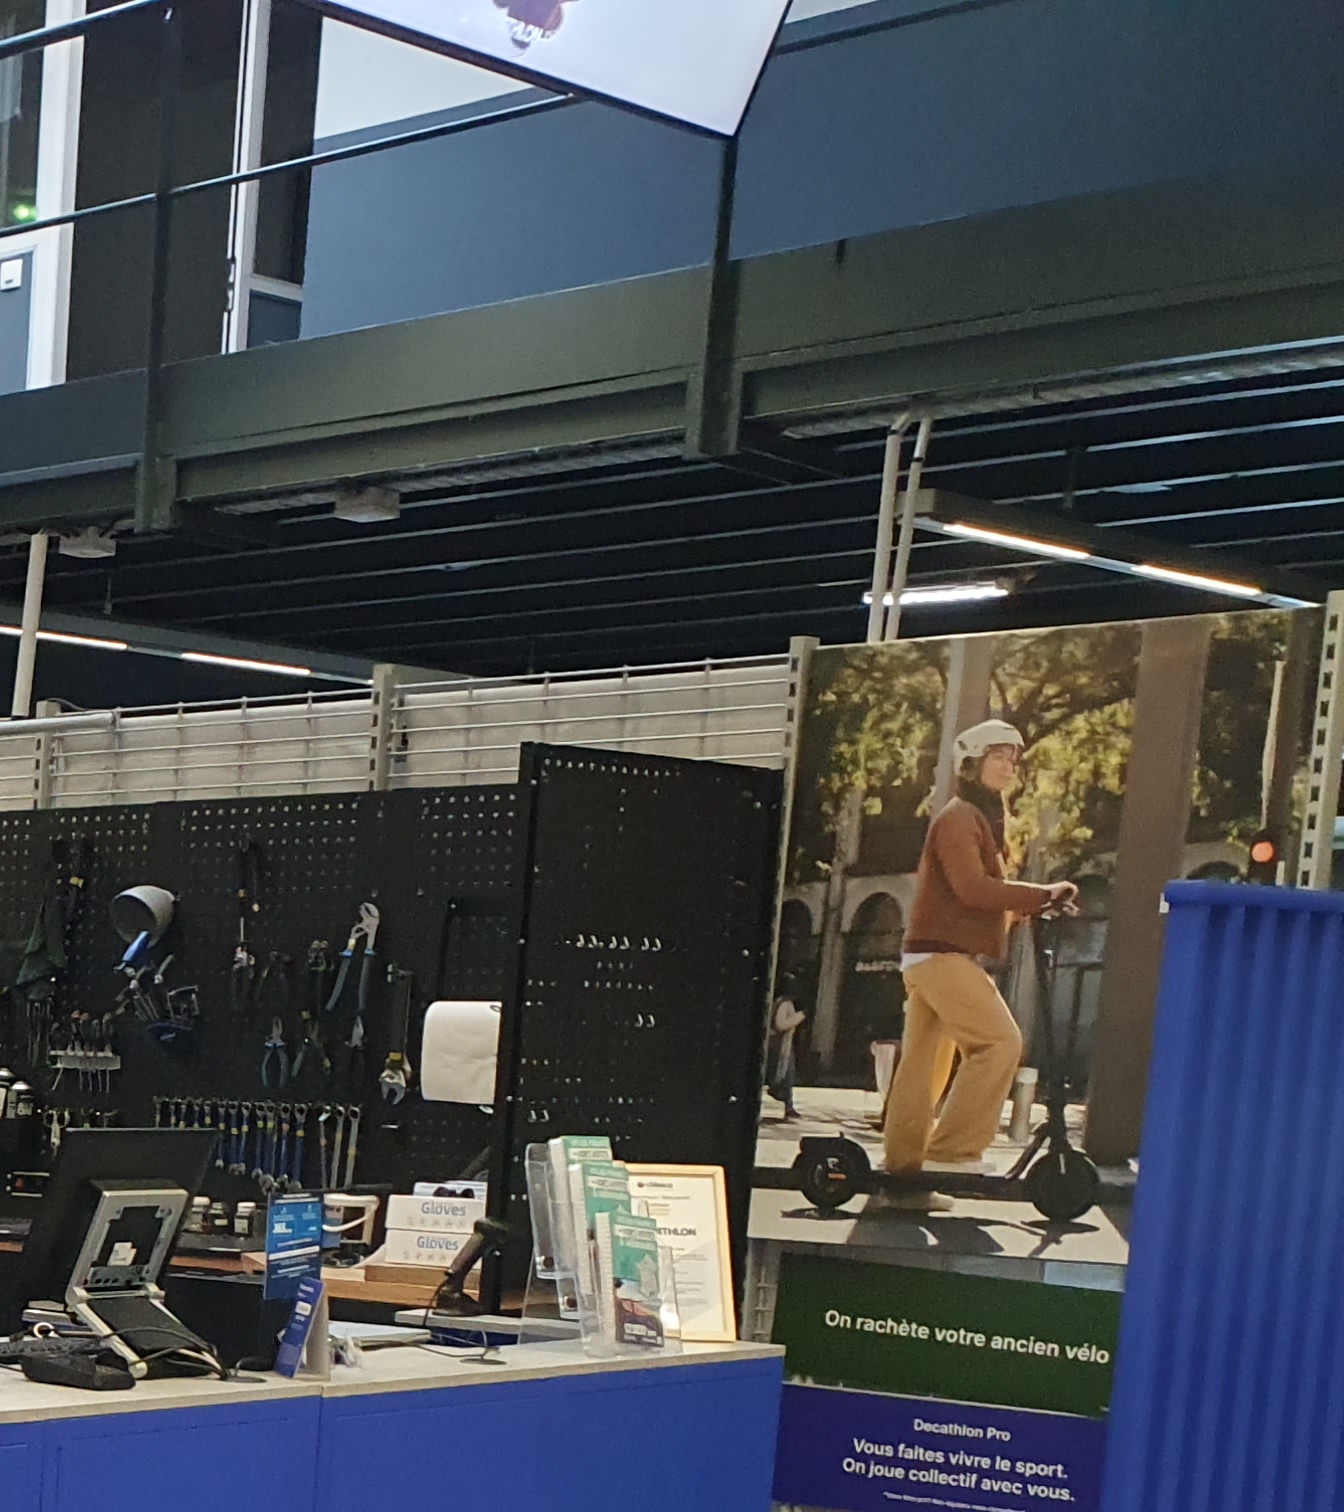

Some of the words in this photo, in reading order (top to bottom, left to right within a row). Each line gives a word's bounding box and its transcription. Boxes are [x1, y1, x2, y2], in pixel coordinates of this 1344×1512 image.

[421, 1201, 467, 1217] Gloves
[416, 1235, 459, 1251] Gloves
[825, 1309, 851, 1328] On
[856, 1316, 930, 1339] rachète
[934, 1327, 986, 1347] votre
[990, 1335, 1060, 1357] ancien
[1065, 1342, 1110, 1364] vélo
[913, 1418, 983, 1439] Decathlon
[987, 1426, 1011, 1441] Pro
[853, 1438, 894, 1456] Vous
[898, 1443, 945, 1463] faites
[949, 1450, 991, 1469] vivre
[995, 1455, 1012, 1472] le
[1015, 1461, 1068, 1478] sport.
[842, 1457, 865, 1474] On
[868, 1460, 905, 1478] joue
[908, 1469, 979, 1488] collectif
[981, 1477, 1023, 1495] avec
[1027, 1483, 1075, 1501] vous.
